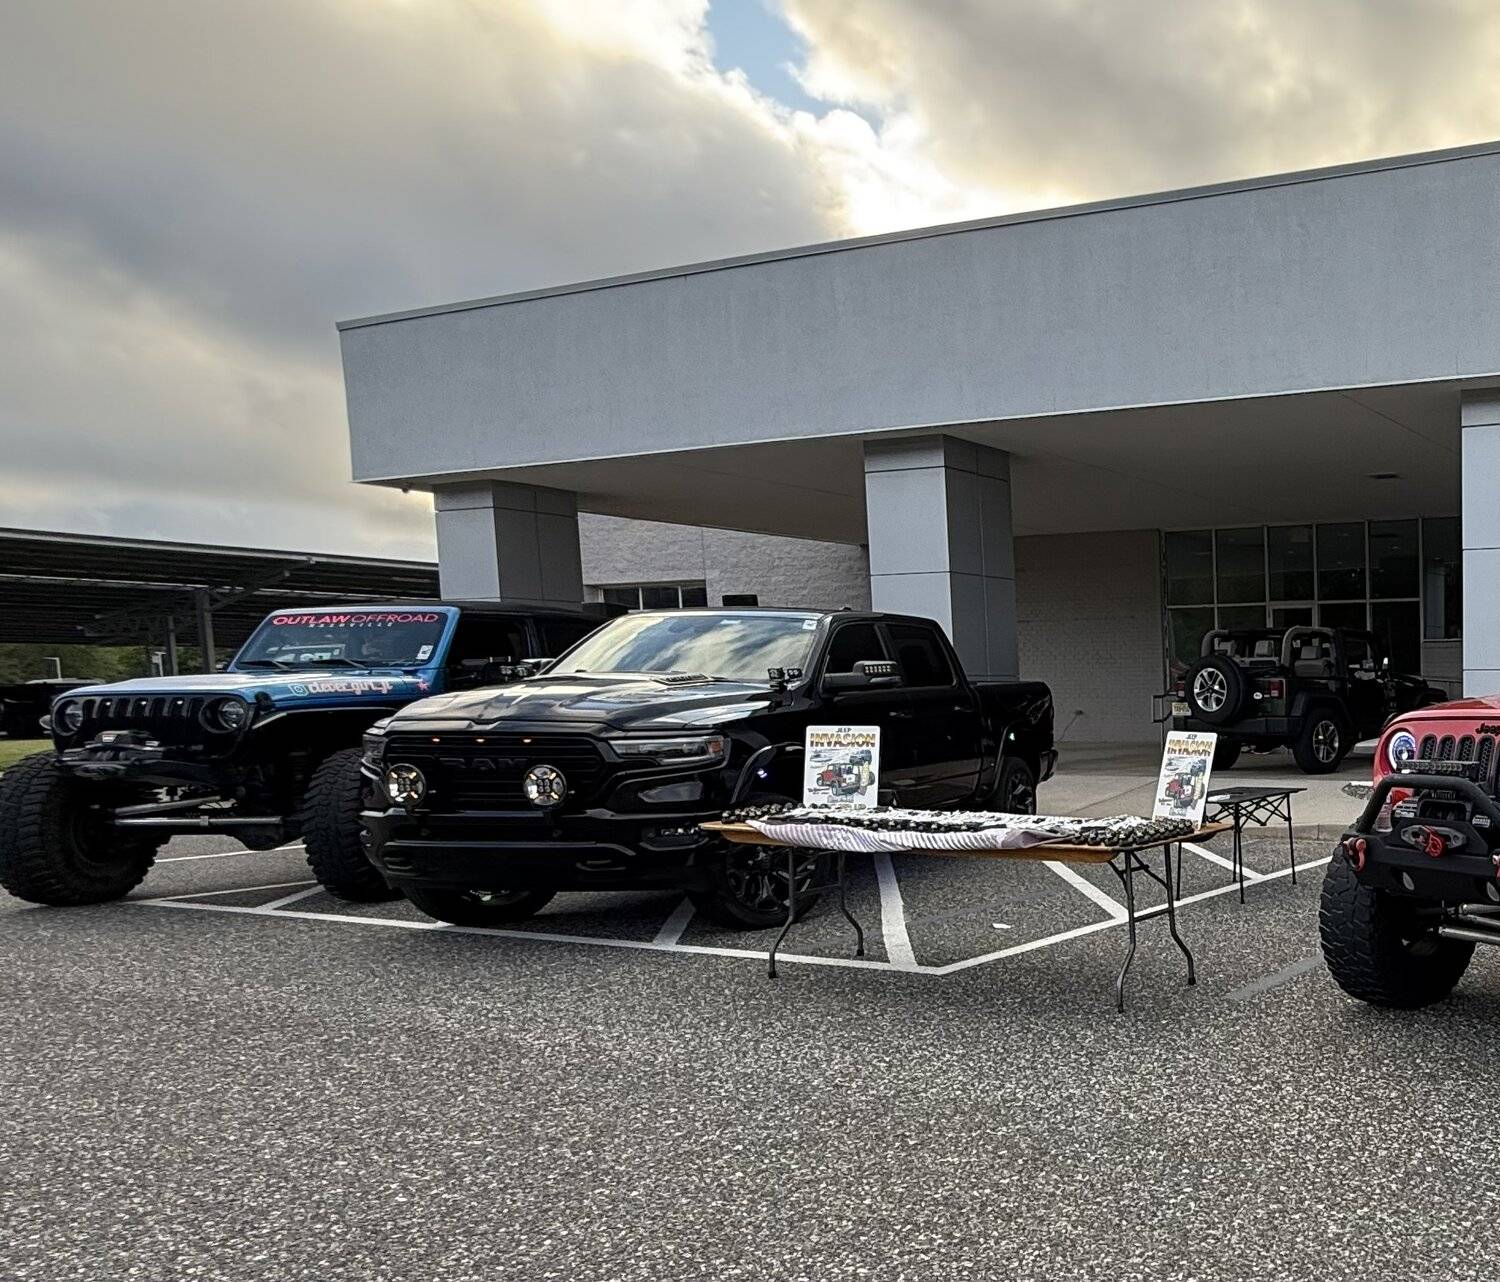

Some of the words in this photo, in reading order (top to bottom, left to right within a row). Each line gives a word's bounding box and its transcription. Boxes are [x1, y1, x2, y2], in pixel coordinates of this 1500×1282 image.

[272, 615, 351, 625] OUTLAW
[351, 613, 439, 623] OFFROAD
[810, 733, 876, 747] INVASION
[1167, 739, 1213, 757] INVASION
[439, 758, 530, 770] RAM
